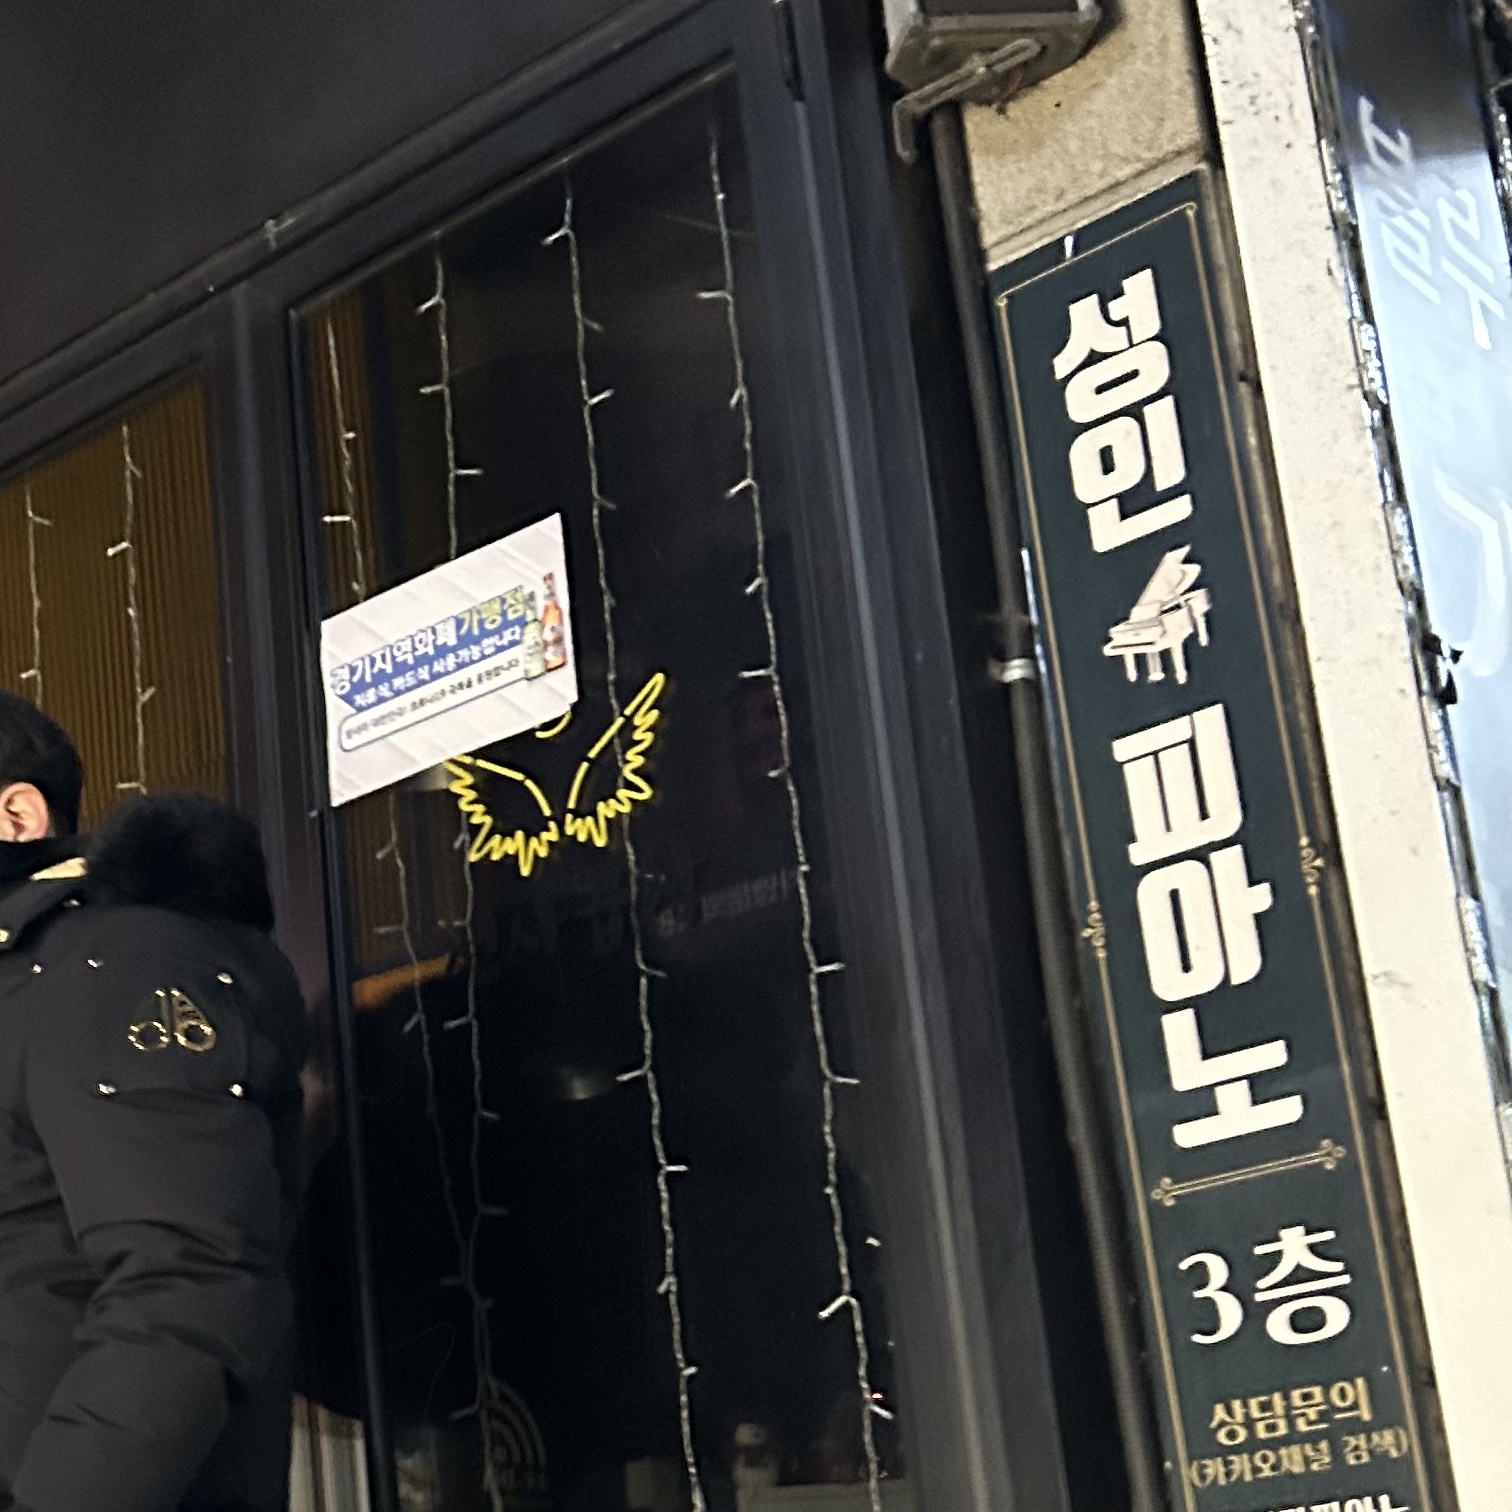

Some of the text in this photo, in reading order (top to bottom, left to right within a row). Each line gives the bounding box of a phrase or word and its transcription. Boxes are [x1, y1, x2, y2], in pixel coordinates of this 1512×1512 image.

[1052, 267, 1305, 1149] 성인 피아노
[1178, 1225, 1352, 1345] 3층
[1209, 1375, 1373, 1447] 상담문의
